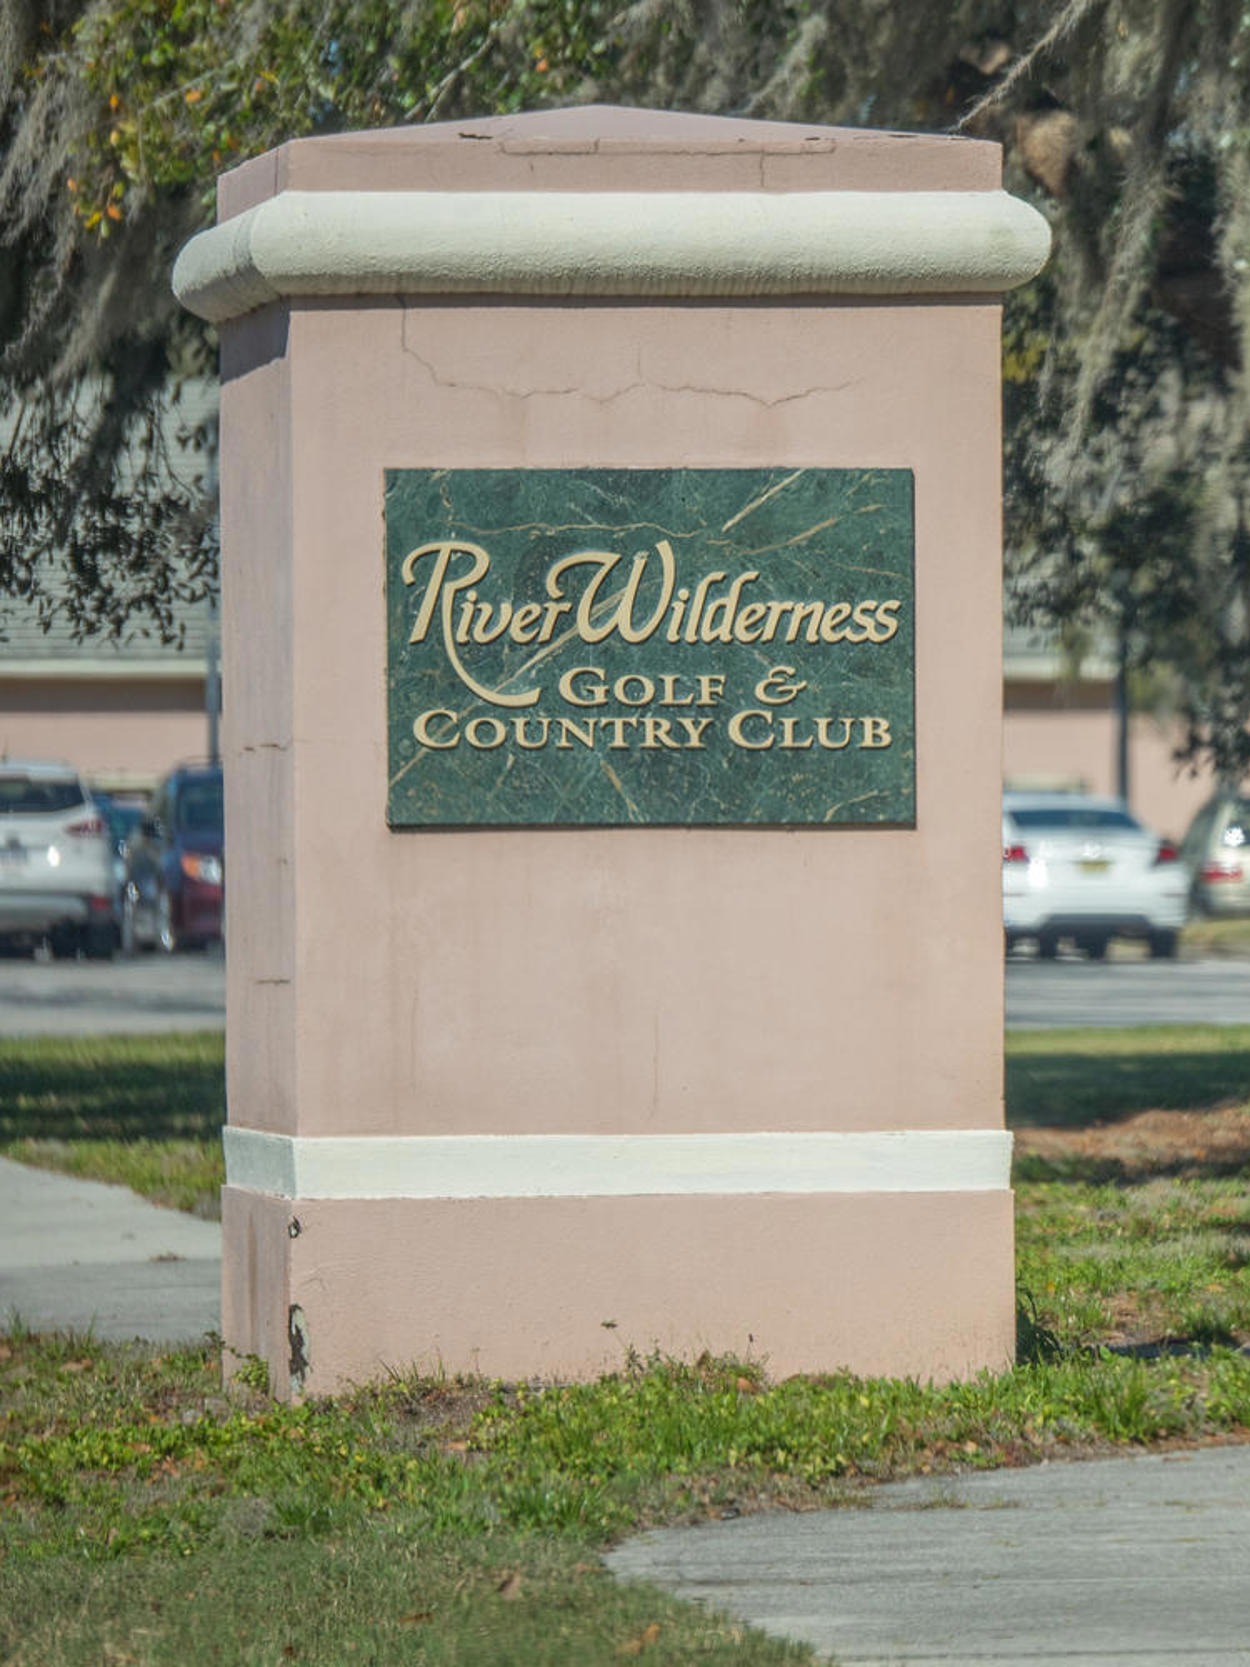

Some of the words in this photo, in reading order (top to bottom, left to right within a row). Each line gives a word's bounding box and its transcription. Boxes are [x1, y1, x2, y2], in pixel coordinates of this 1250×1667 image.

[402, 540, 572, 708] River
[546, 539, 901, 645] Wilderness
[558, 666, 726, 708] GOLF
[754, 665, 808, 706] &
[411, 708, 714, 751] COUNTRY
[727, 709, 894, 751] CLUB
